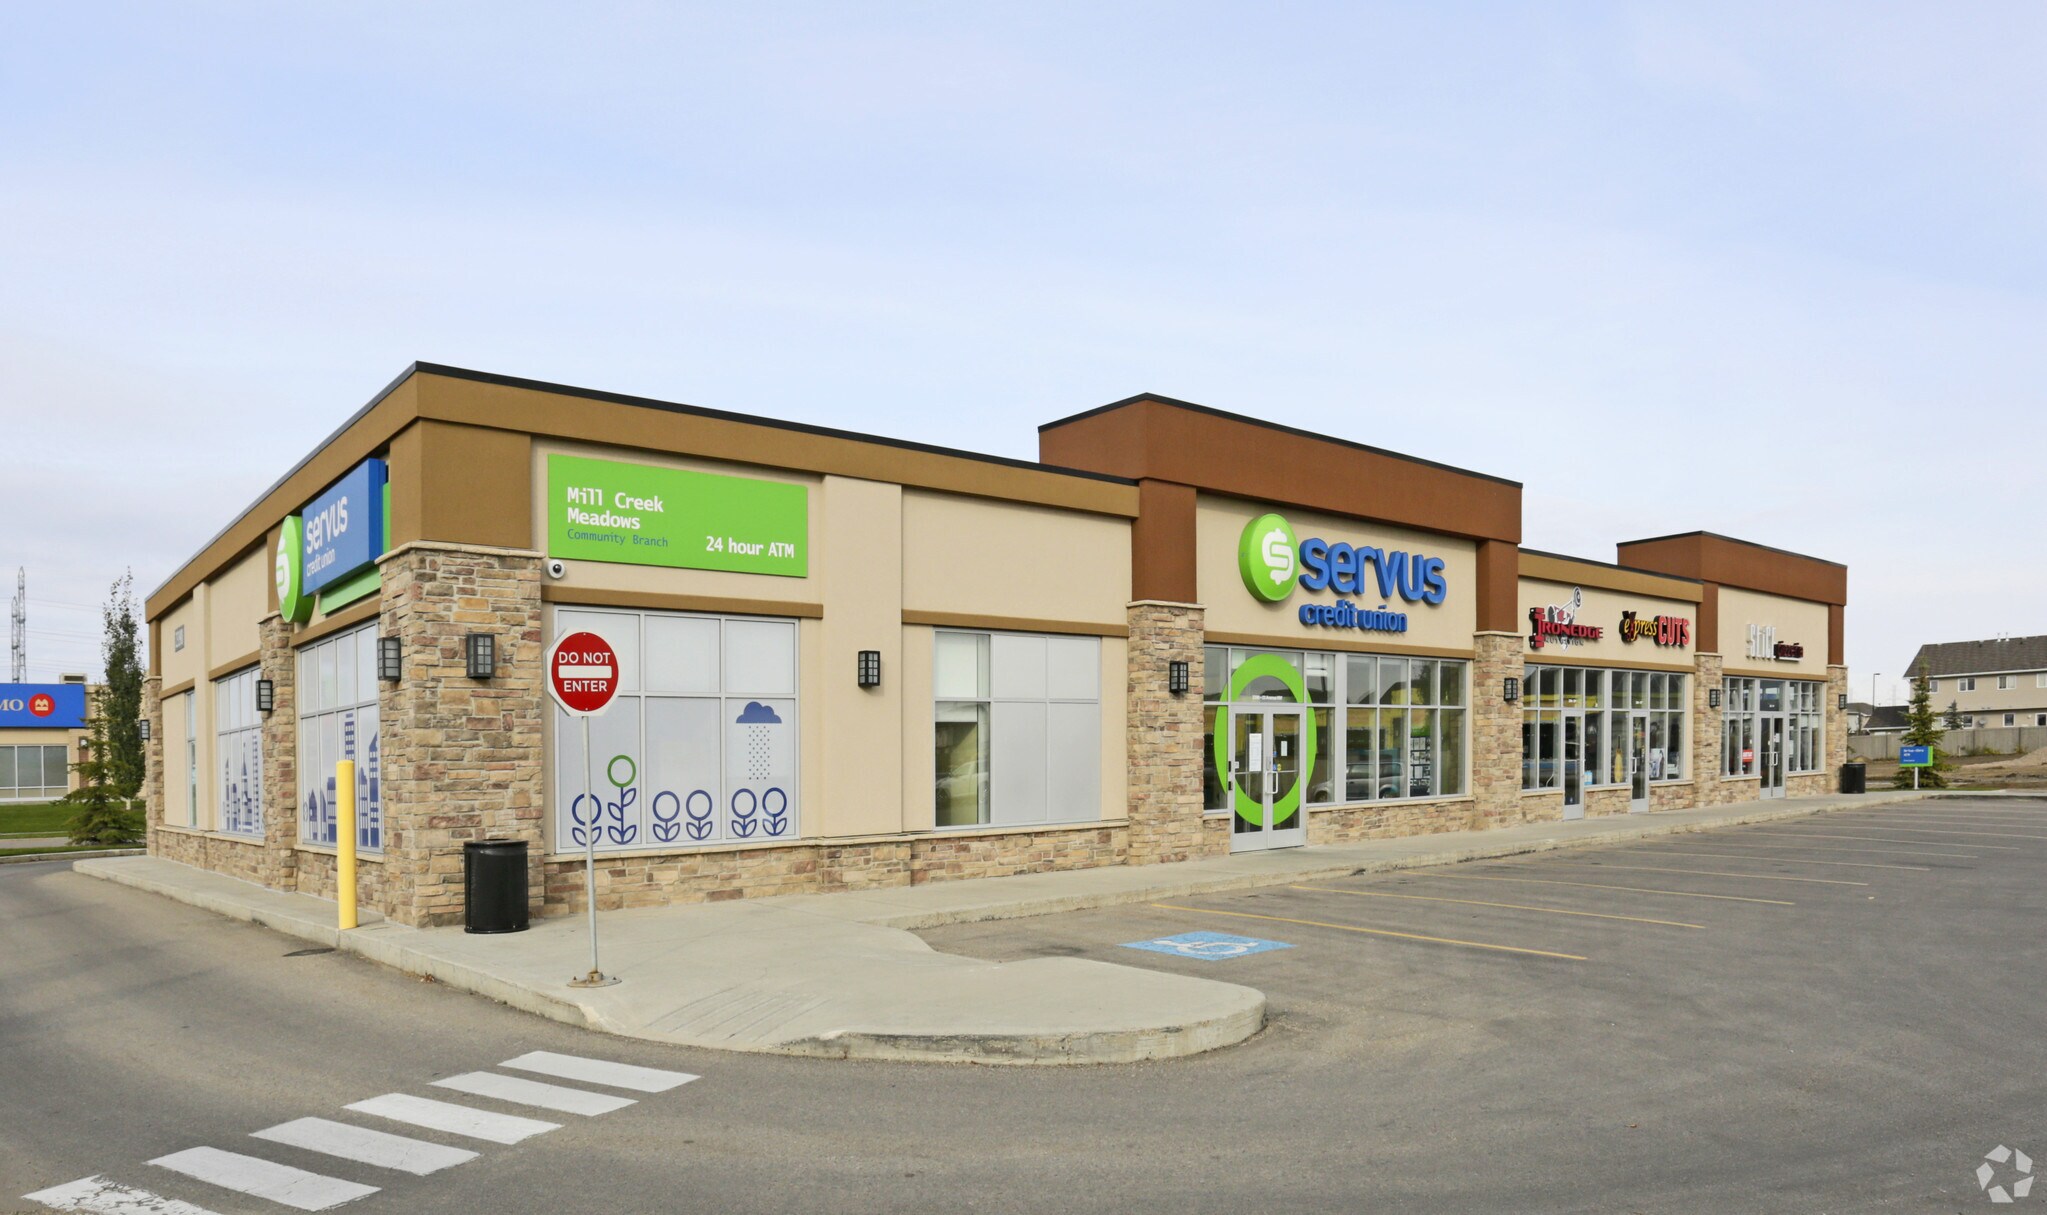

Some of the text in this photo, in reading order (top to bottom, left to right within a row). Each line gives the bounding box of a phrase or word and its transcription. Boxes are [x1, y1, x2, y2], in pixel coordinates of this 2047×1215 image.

[567, 486, 664, 513] Mill Creek
[306, 496, 348, 554] servus
[567, 507, 641, 530] Meadows
[567, 528, 669, 547] Community Branch
[706, 536, 795, 559] 24 hour ATM
[306, 548, 336, 577] credit union
[1299, 537, 1447, 605] servus
[1299, 599, 1407, 632] credit union
[1656, 615, 1690, 647] CUTS
[558, 652, 610, 664] DO NOT
[563, 680, 608, 693] ENTER
